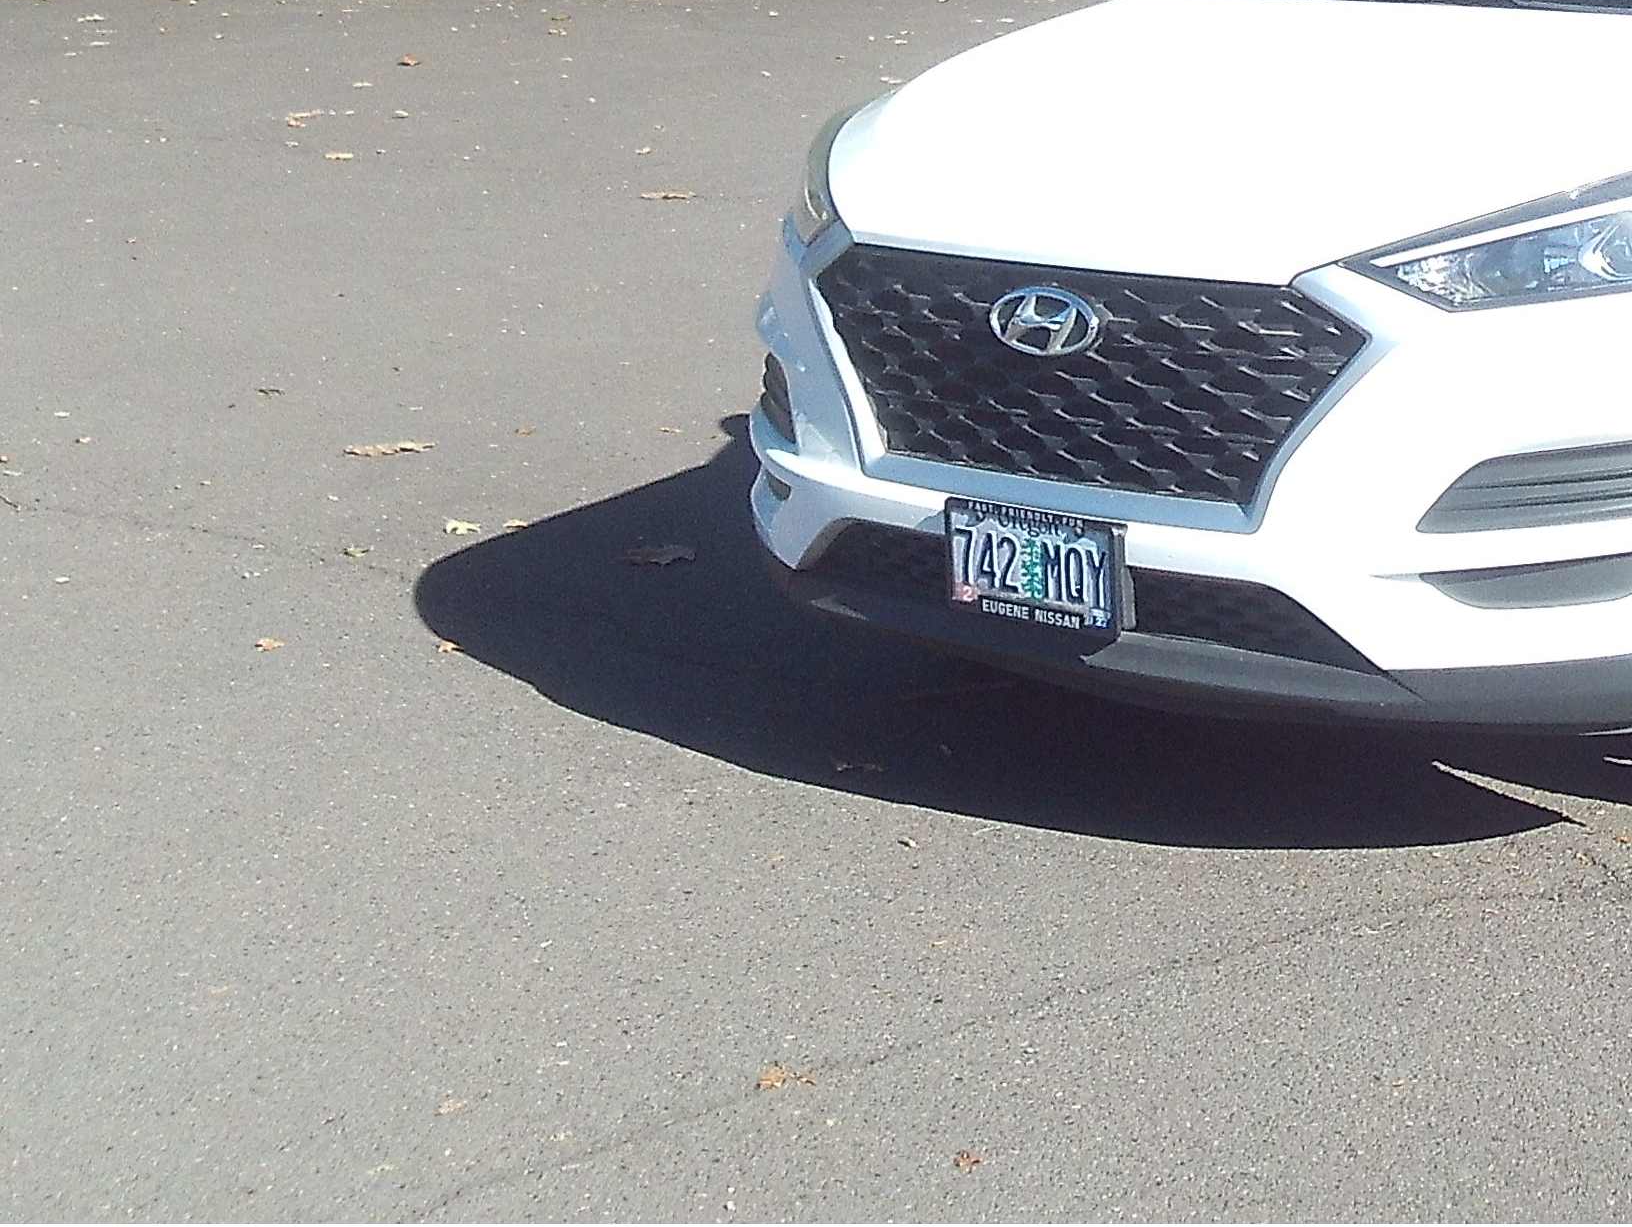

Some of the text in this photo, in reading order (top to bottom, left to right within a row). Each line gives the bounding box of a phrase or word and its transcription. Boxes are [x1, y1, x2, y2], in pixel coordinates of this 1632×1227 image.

[955, 526, 1020, 592] 742
[982, 598, 1081, 630] EUGENE NISSAN
